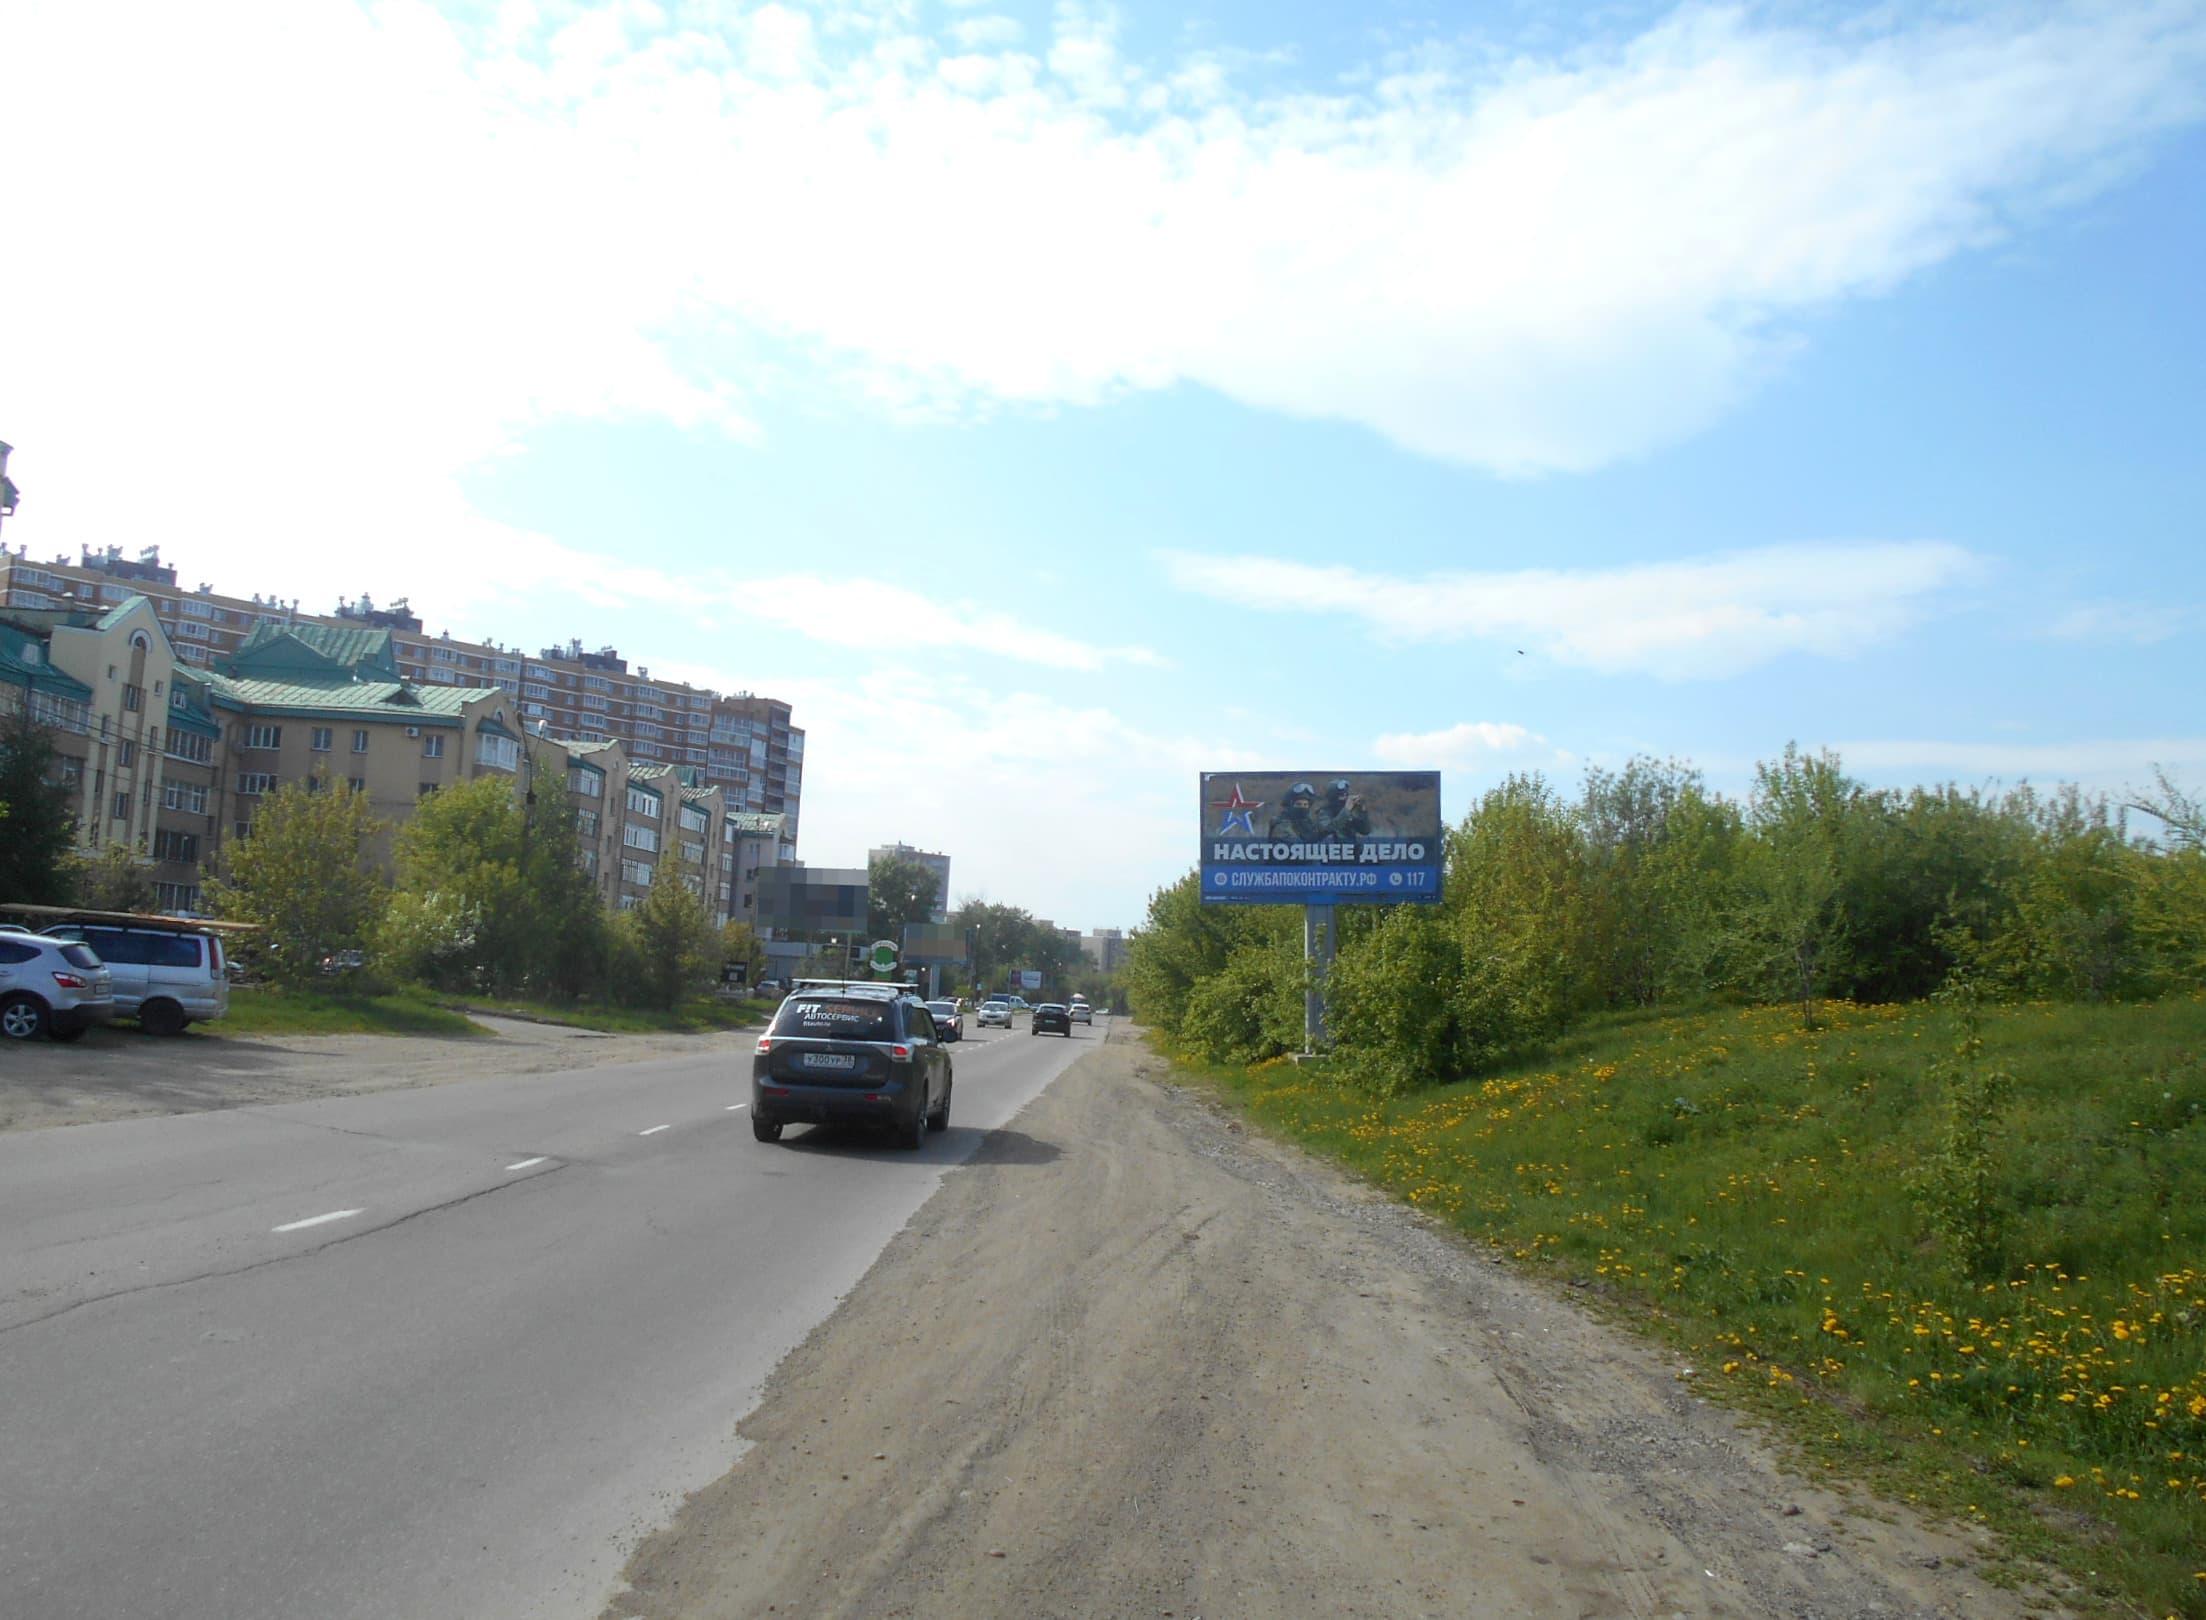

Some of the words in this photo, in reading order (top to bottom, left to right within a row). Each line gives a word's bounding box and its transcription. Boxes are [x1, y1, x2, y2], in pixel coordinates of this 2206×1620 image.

[1214, 843, 1355, 863] НАСТОЯЩЕЕ
[1360, 843, 1424, 863] ДЕЛО
[1232, 872, 1377, 887] СЛУЖБАПОКОНТРАКТУ.РФ
[1407, 872, 1424, 886] 117
[796, 1004, 821, 1013] FIT
